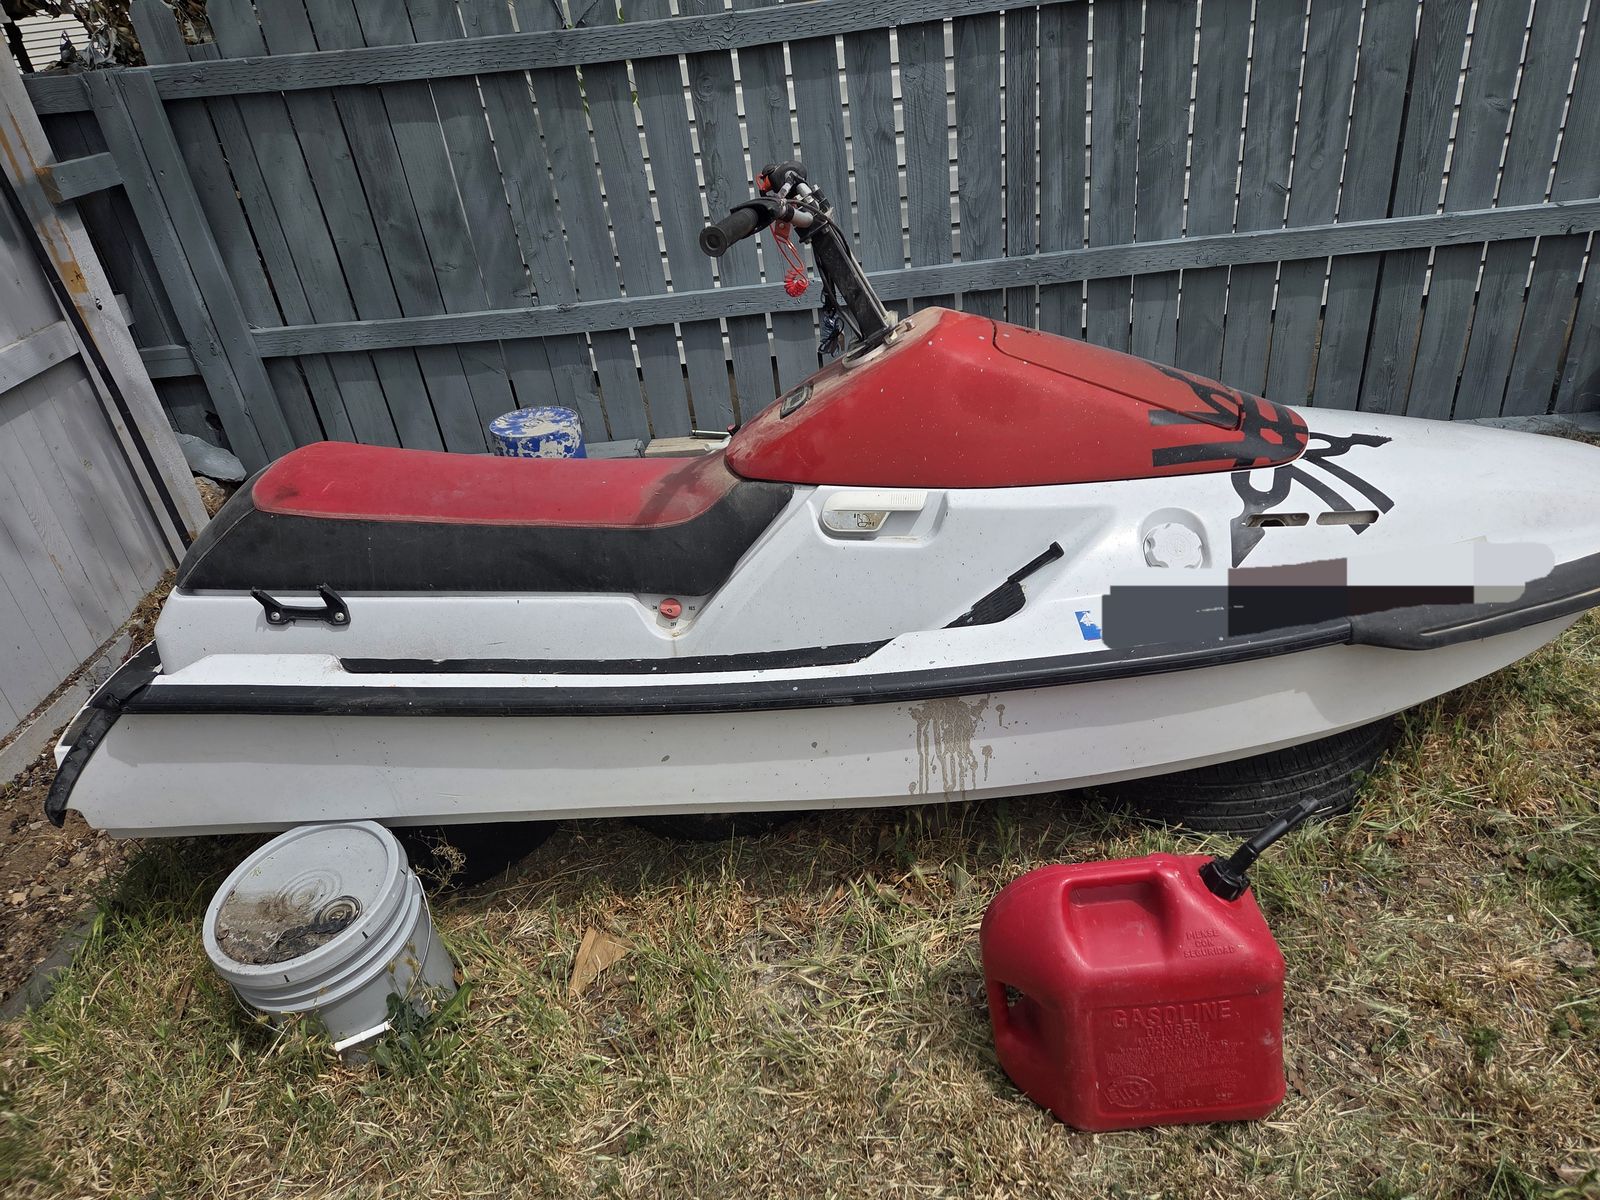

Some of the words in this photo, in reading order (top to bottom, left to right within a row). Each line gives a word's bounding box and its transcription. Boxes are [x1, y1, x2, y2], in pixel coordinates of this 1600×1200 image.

[1184, 945, 1235, 959] SEGURIDAD
[1111, 999, 1232, 1029] GASOLINE
[1146, 1022, 1200, 1037] DANGER
